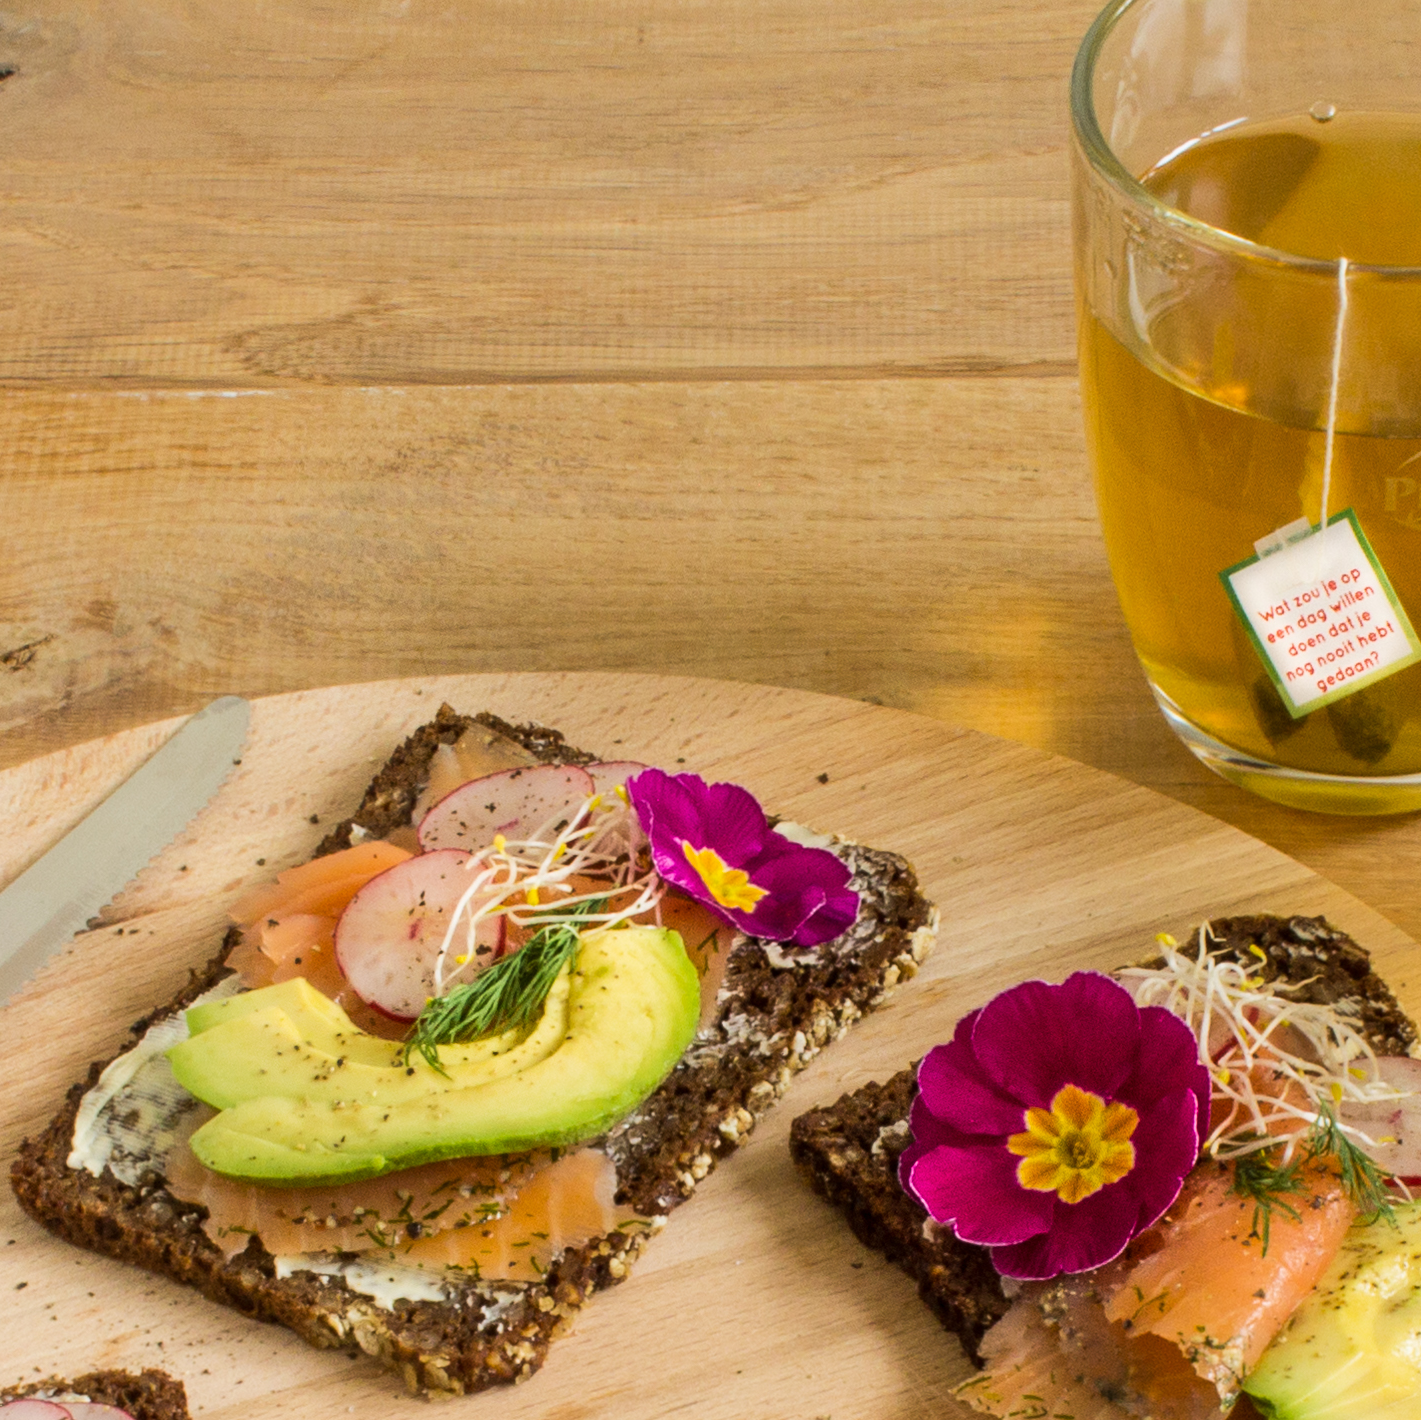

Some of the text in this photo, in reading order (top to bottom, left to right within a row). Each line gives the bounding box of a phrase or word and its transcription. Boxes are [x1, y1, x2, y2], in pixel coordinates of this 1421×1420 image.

[1257, 567, 1362, 623] Wat zou je op
[1266, 585, 1375, 644] een dag willen
[1285, 621, 1395, 682] nog nooit hebt
[1288, 610, 1372, 657] doen dat je
[1316, 651, 1380, 693] gedaan?
